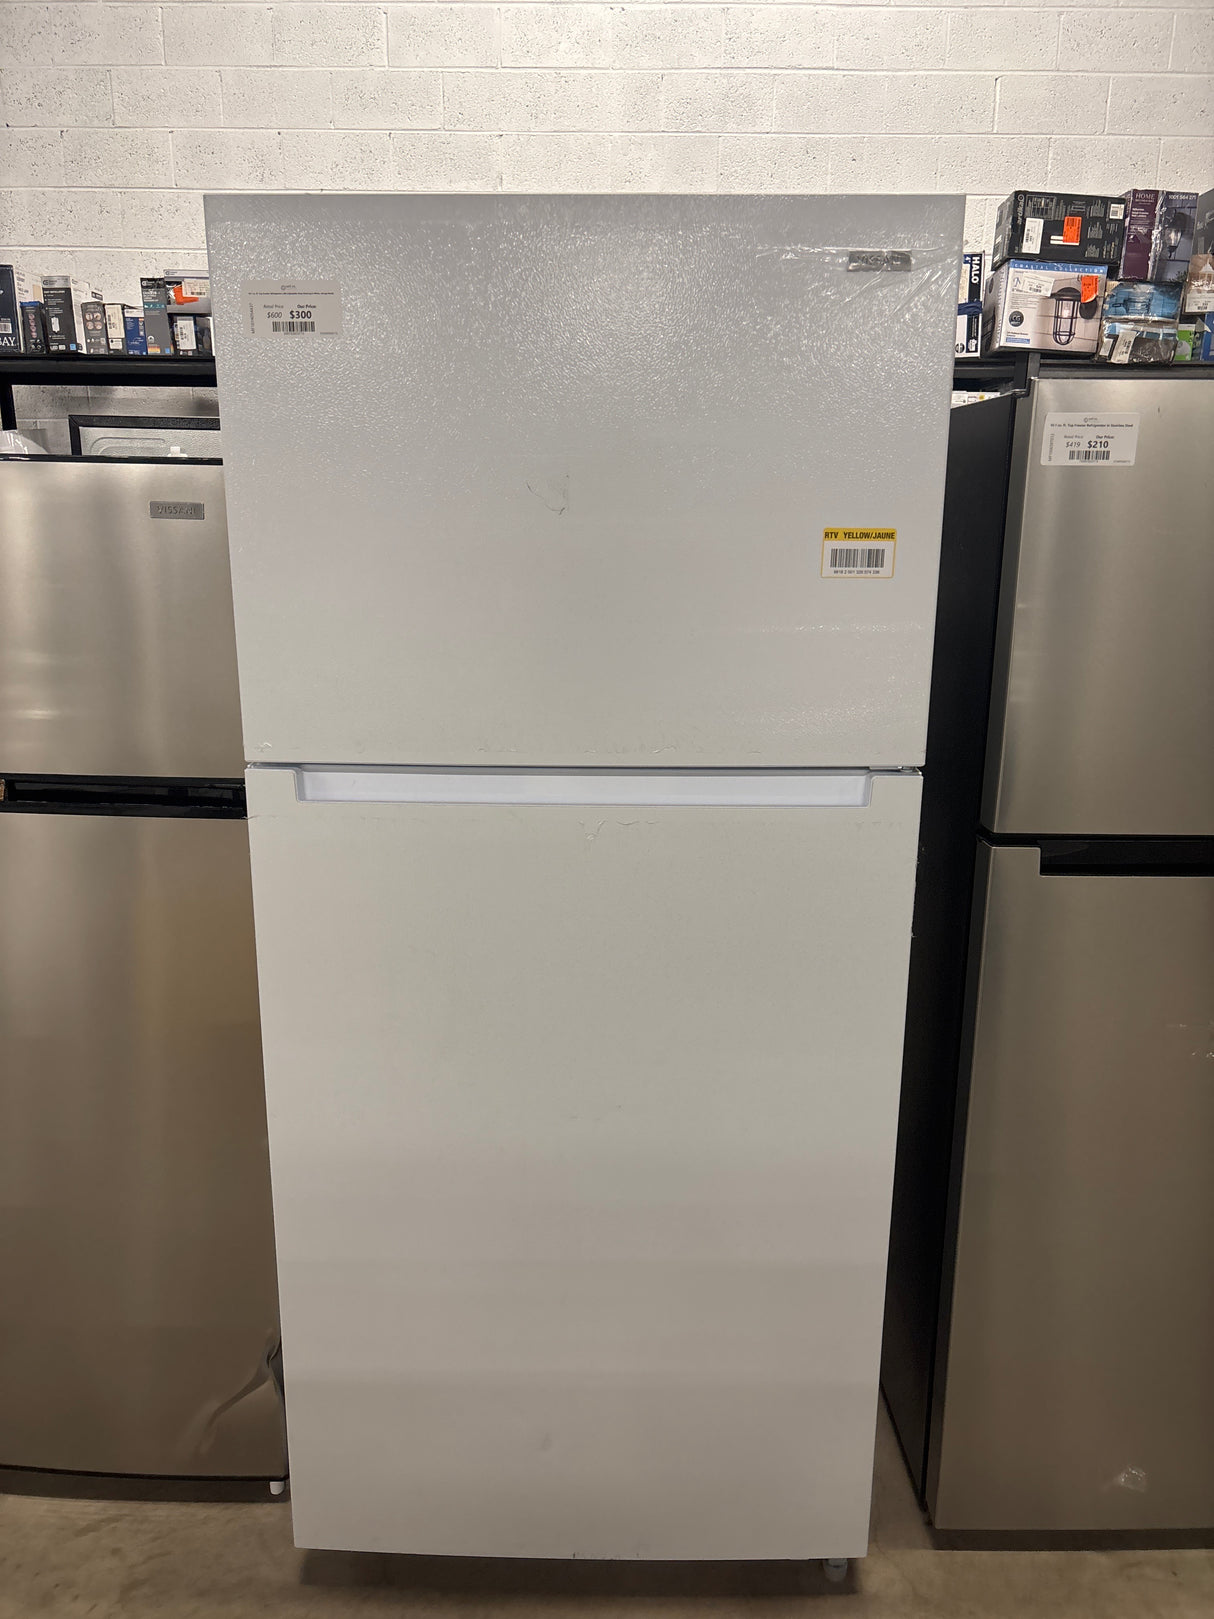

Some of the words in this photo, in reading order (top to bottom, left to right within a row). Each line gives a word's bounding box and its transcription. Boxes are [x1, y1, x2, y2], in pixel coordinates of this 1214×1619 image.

[971, 256, 981, 284] HALO
[266, 311, 283, 319] $600
[289, 310, 312, 319] $300
[0, 336, 15, 346] AY
[1065, 441, 1081, 449] $419
[1087, 440, 1109, 449] $210
[824, 531, 839, 539] RTV
[843, 531, 895, 539] YELLOW/JAUNE
